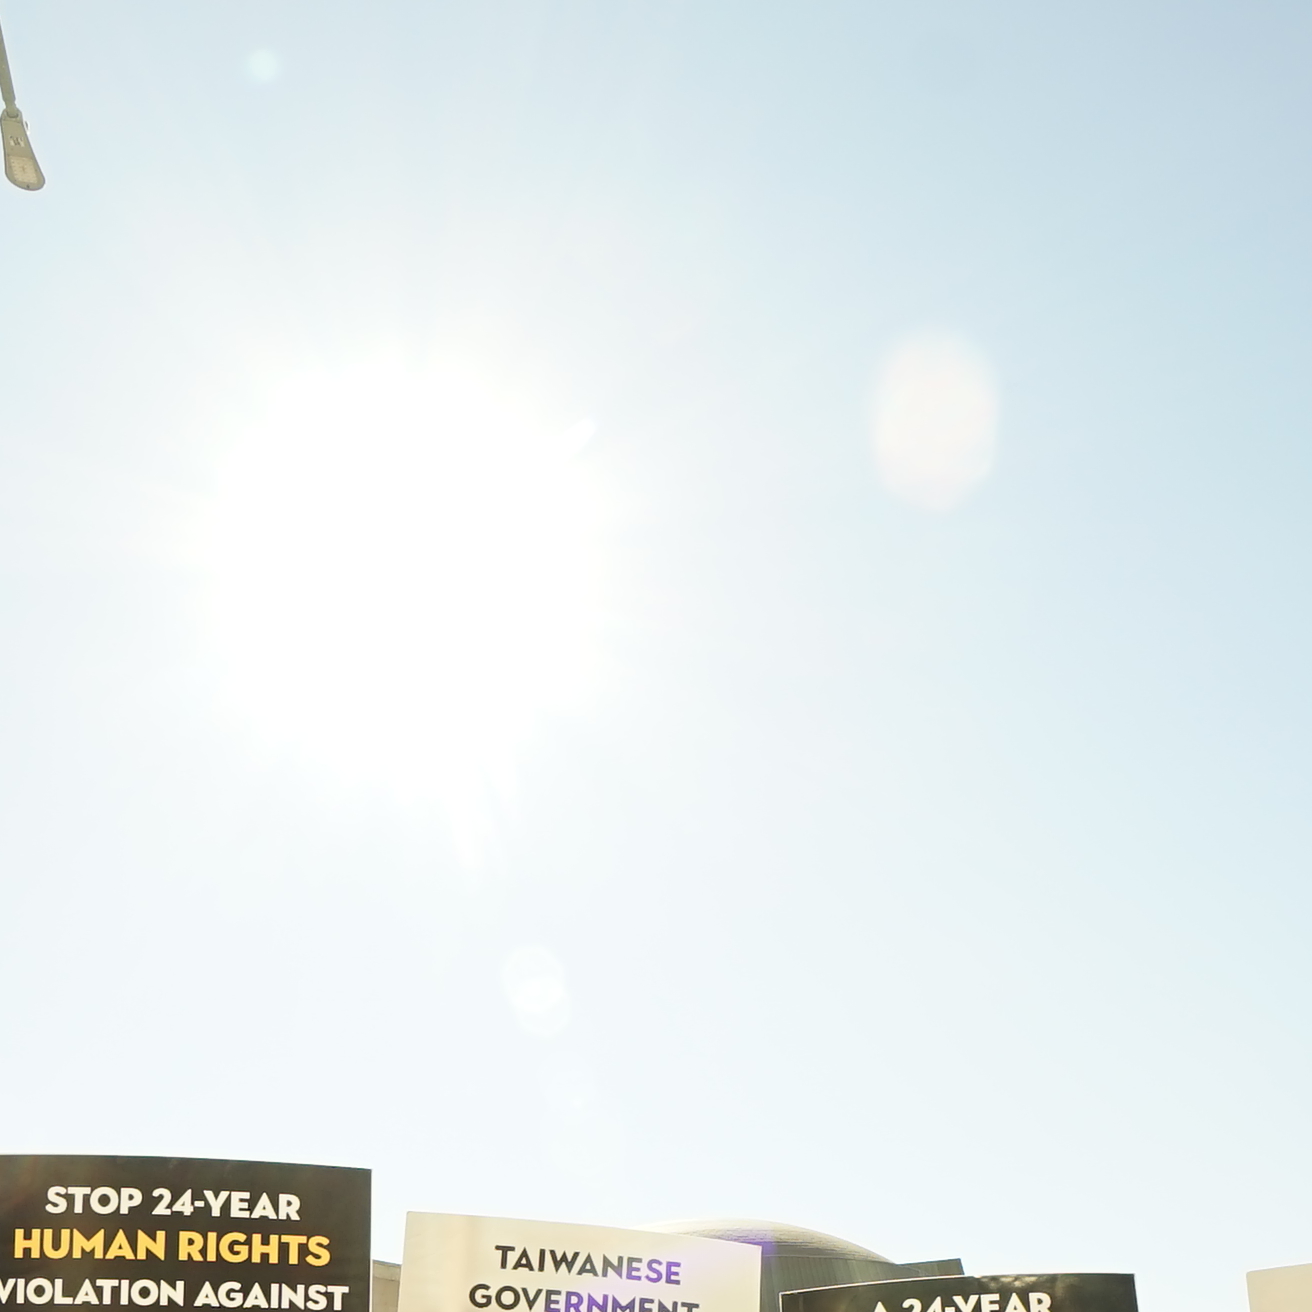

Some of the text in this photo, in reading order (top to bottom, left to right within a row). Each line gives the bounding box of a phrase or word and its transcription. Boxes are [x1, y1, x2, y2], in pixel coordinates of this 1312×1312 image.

[45, 1186, 300, 1220] STOP 24-YEAR
[14, 1229, 330, 1266] HUMAN RIGHTS
[495, 1245, 682, 1285] TAIWANESE
[194, 1281, 349, 1310] AGAINST
